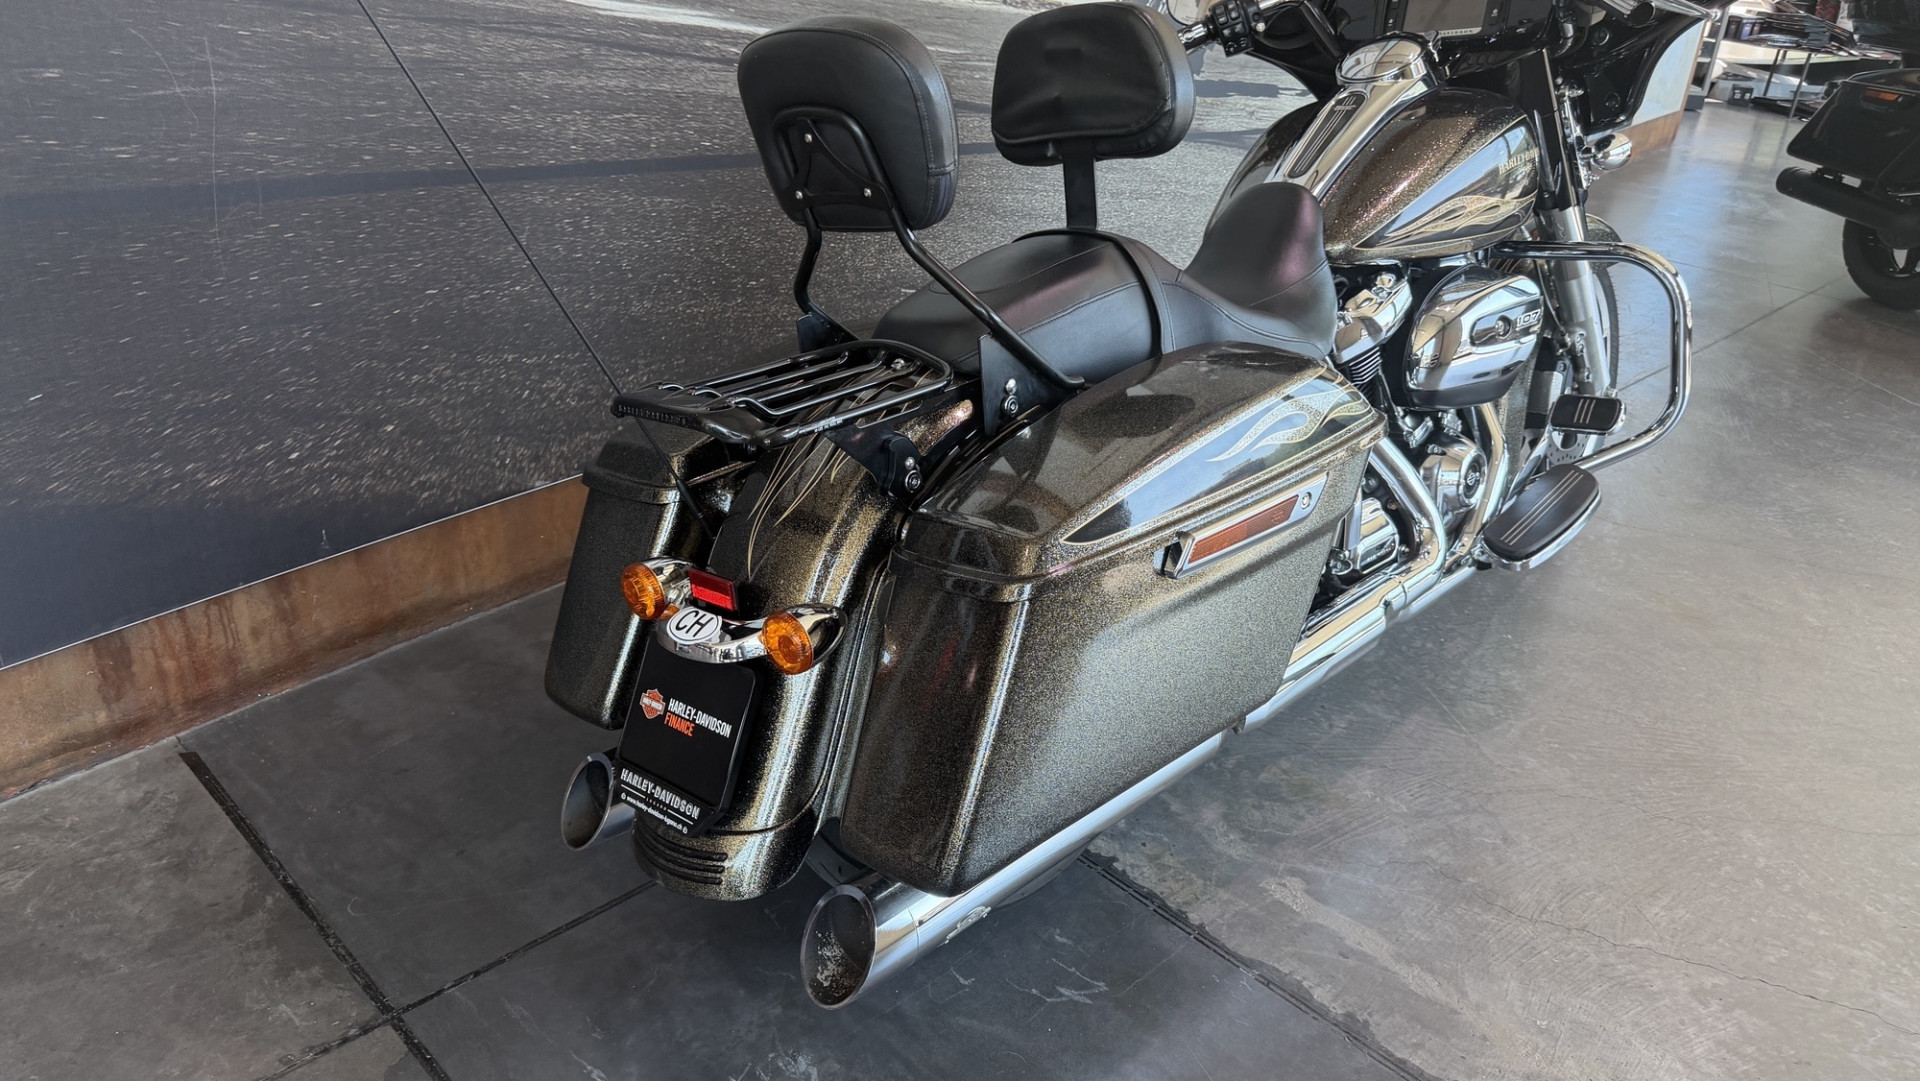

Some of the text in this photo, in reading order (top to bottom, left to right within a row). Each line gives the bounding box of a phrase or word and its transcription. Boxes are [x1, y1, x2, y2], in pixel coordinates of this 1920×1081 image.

[1516, 309, 1541, 328] 107
[675, 610, 714, 638] CH
[664, 711, 695, 737] FINANCE
[667, 697, 732, 738] HARLEY-DAVIDSON
[620, 768, 701, 820] HARLEY-DAVIDSON
